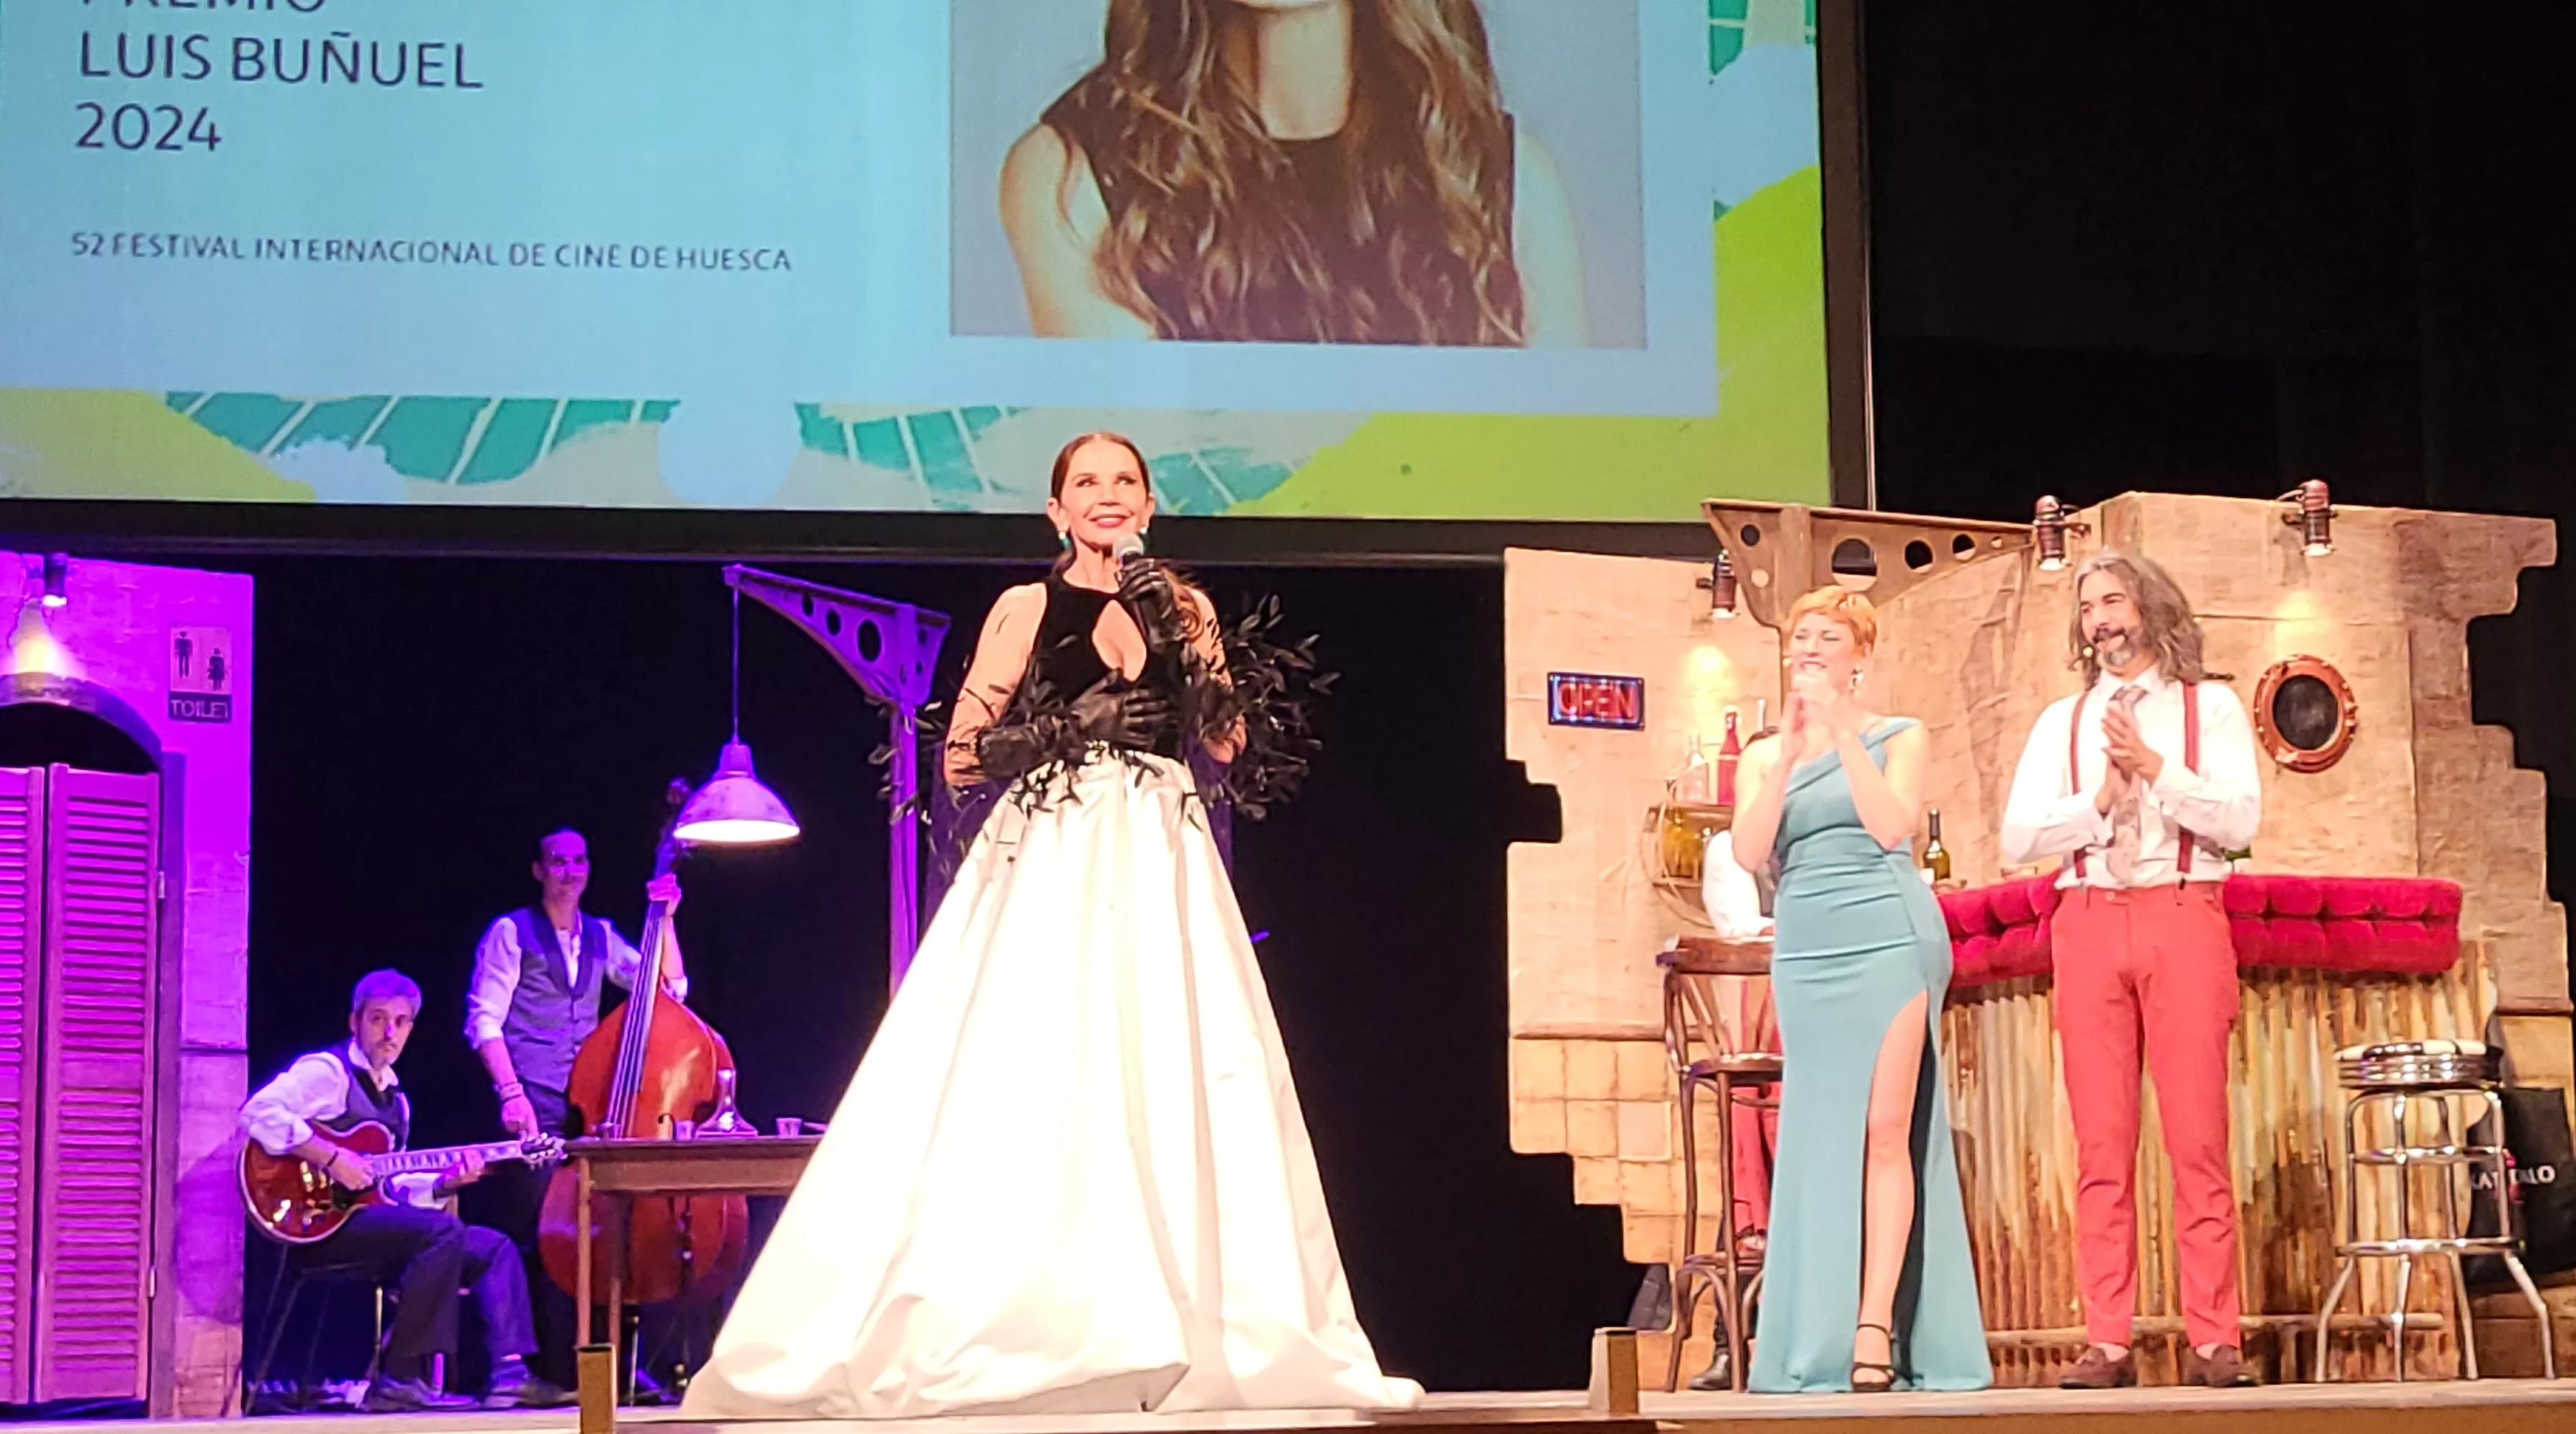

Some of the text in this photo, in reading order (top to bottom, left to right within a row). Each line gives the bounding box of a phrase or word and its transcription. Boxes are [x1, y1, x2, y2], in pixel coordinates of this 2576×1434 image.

[80, 30, 484, 89] LUIS BUÑUEL
[75, 101, 222, 153] 2024
[71, 232, 791, 271] 52 FESTIVAL INTERNACIONAL DE CINE DE HUESCA
[171, 699, 228, 719] TOILET
[1559, 683, 1637, 719] OPEN
